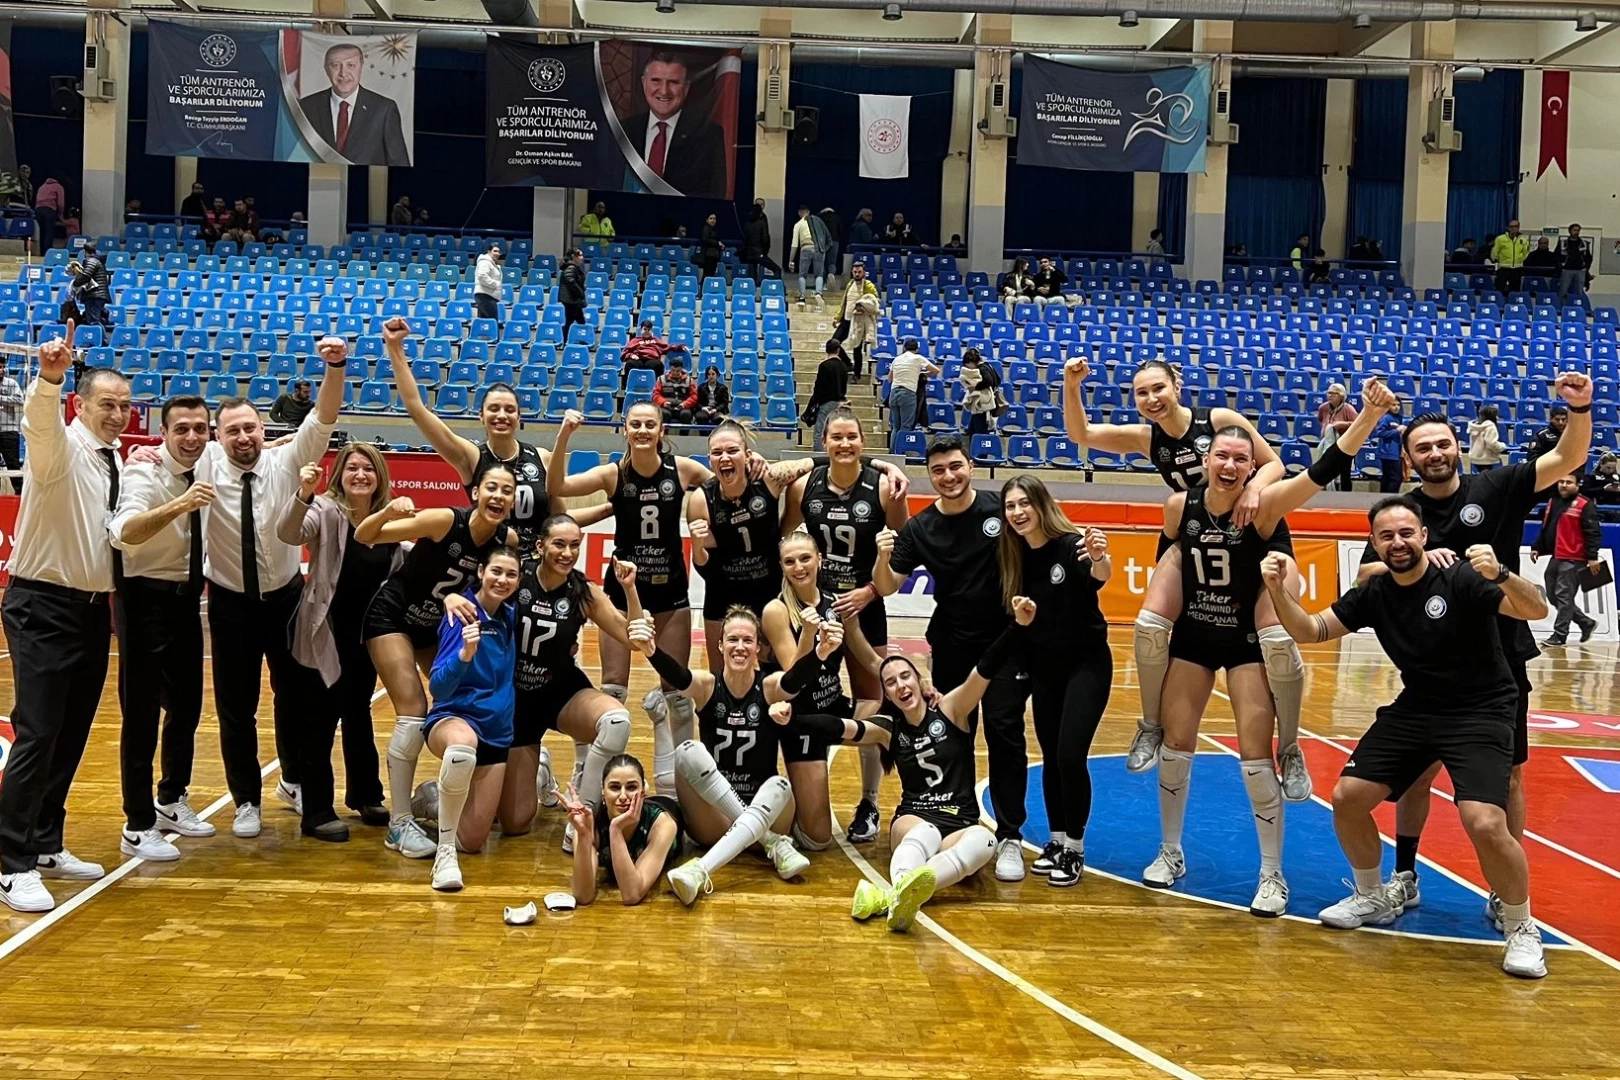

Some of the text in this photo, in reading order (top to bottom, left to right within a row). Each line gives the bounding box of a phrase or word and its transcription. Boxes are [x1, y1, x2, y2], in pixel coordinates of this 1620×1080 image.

[180, 75, 255, 88] TÜM ANTRENÖR
[168, 84, 265, 97] VE SPORCULARIMIZA
[169, 96, 263, 107] BAŞARILAR DİLİYORUM
[1045, 92, 1112, 107] TÜM ANTRENÖR
[507, 105, 587, 118] TÜM ANTRENÖR
[1036, 101, 1122, 116] VE SPORCULARIMIZA
[184, 114, 202, 122] Recep
[496, 117, 598, 130] VE SPORCULARIMIZA
[1036, 113, 1120, 125] BAŞARILAR DİLİYORUM
[499, 129, 594, 140] BAŞARILAR DİLİYORUM
[558, 159, 581, 167] BAKANI
[397, 480, 421, 489] SPOR
[423, 481, 460, 491] SALONU
[641, 505, 659, 539] 8
[737, 526, 752, 552] 1
[820, 523, 856, 557] 19
[634, 545, 665, 556] Teker
[821, 558, 853, 572] Teker
[1191, 547, 1231, 586] 13
[1196, 590, 1231, 604] Teker
[521, 616, 557, 657] 17
[714, 727, 756, 766] 77
[799, 735, 810, 754] 7
[915, 748, 944, 788] 5
